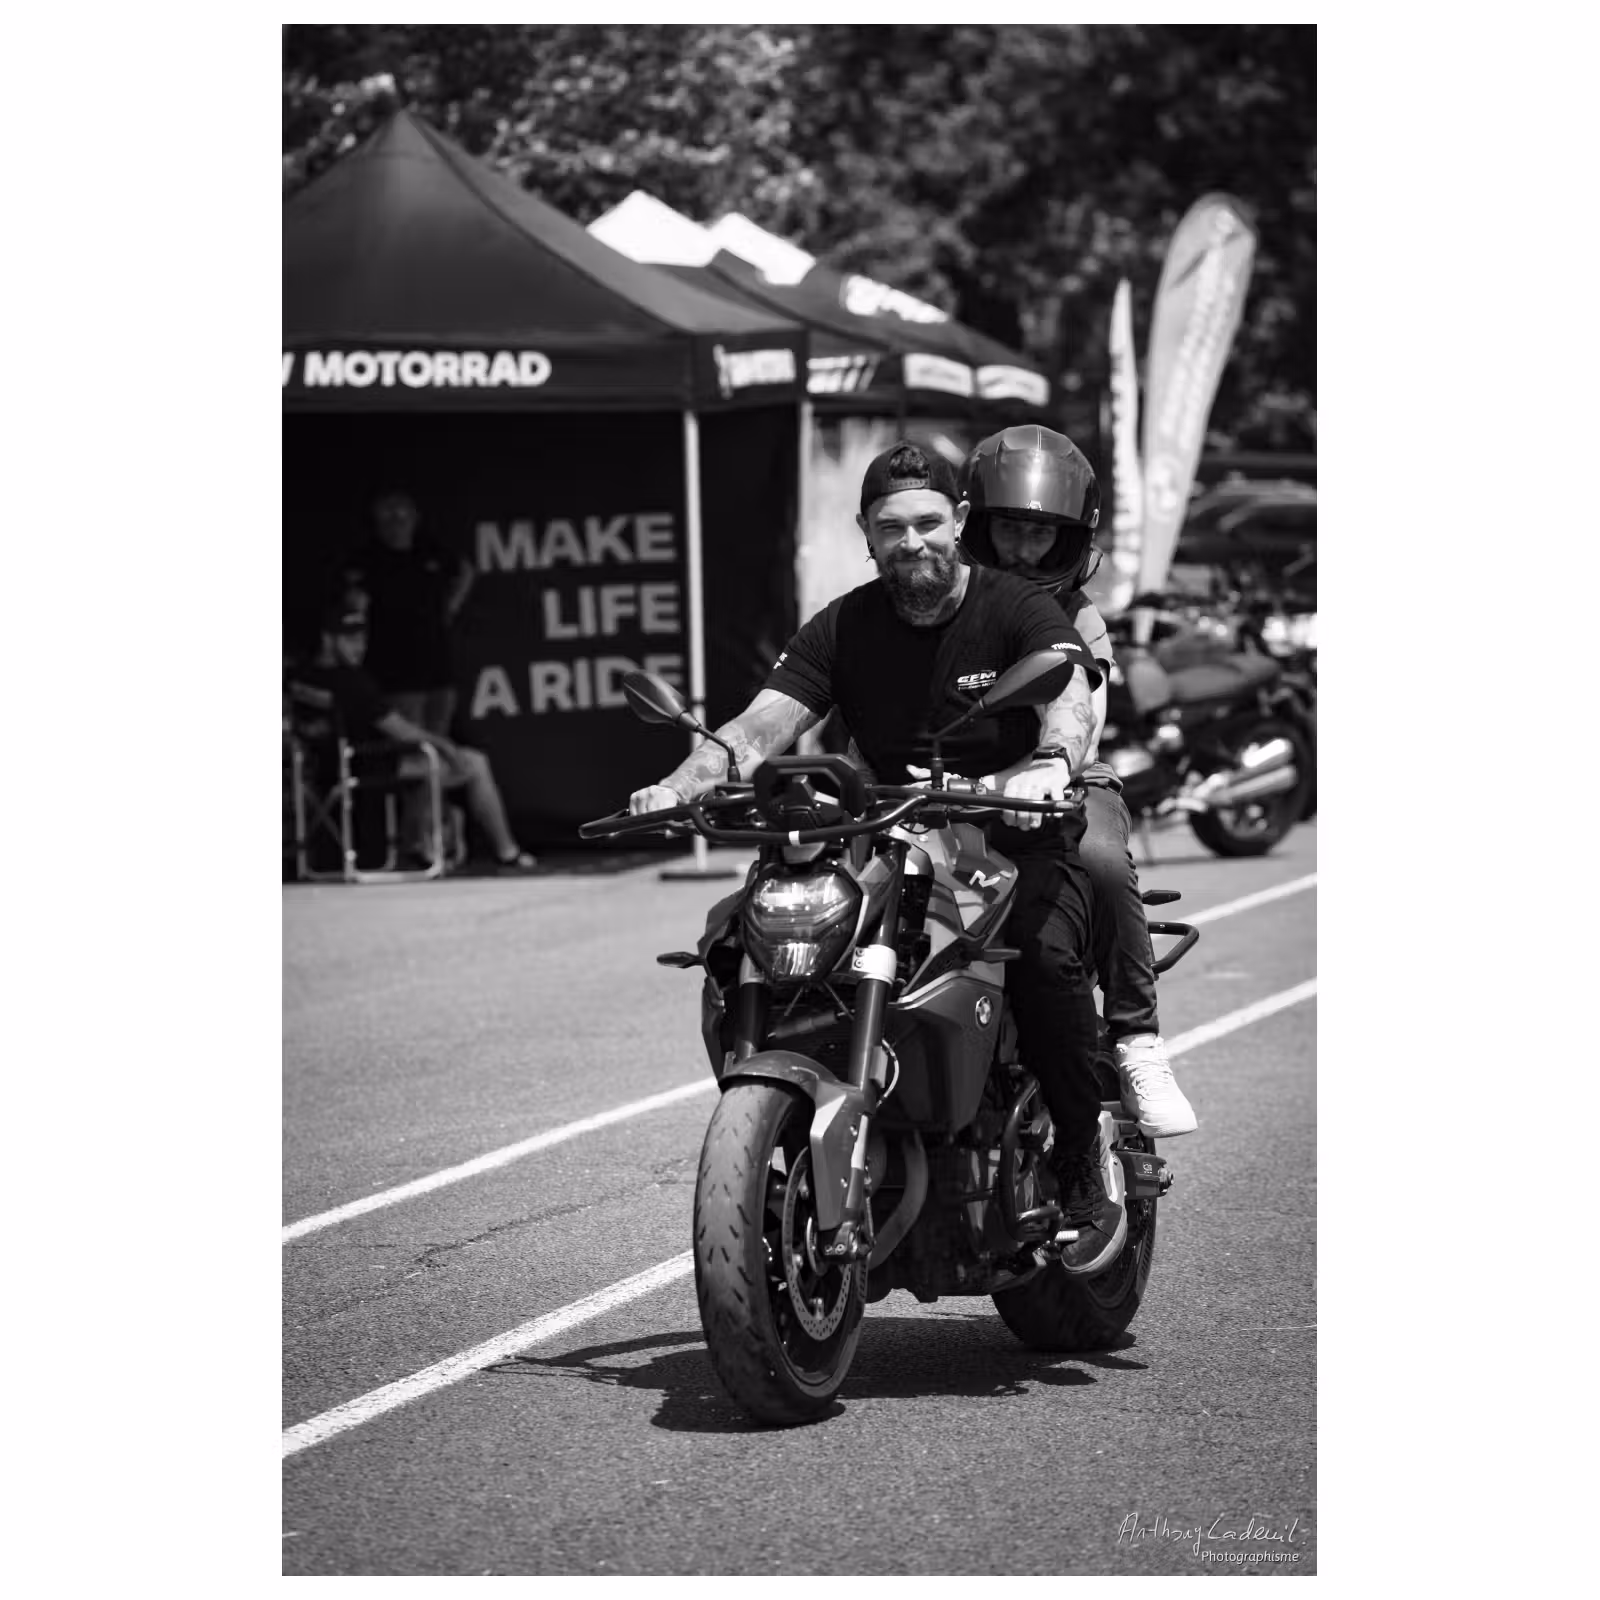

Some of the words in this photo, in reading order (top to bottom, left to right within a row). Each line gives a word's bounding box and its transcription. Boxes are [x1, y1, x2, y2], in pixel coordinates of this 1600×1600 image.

[303, 351, 552, 388] MOTORRAD
[475, 513, 676, 572] MAKE
[543, 581, 681, 639] LIFE
[470, 666, 519, 719] A
